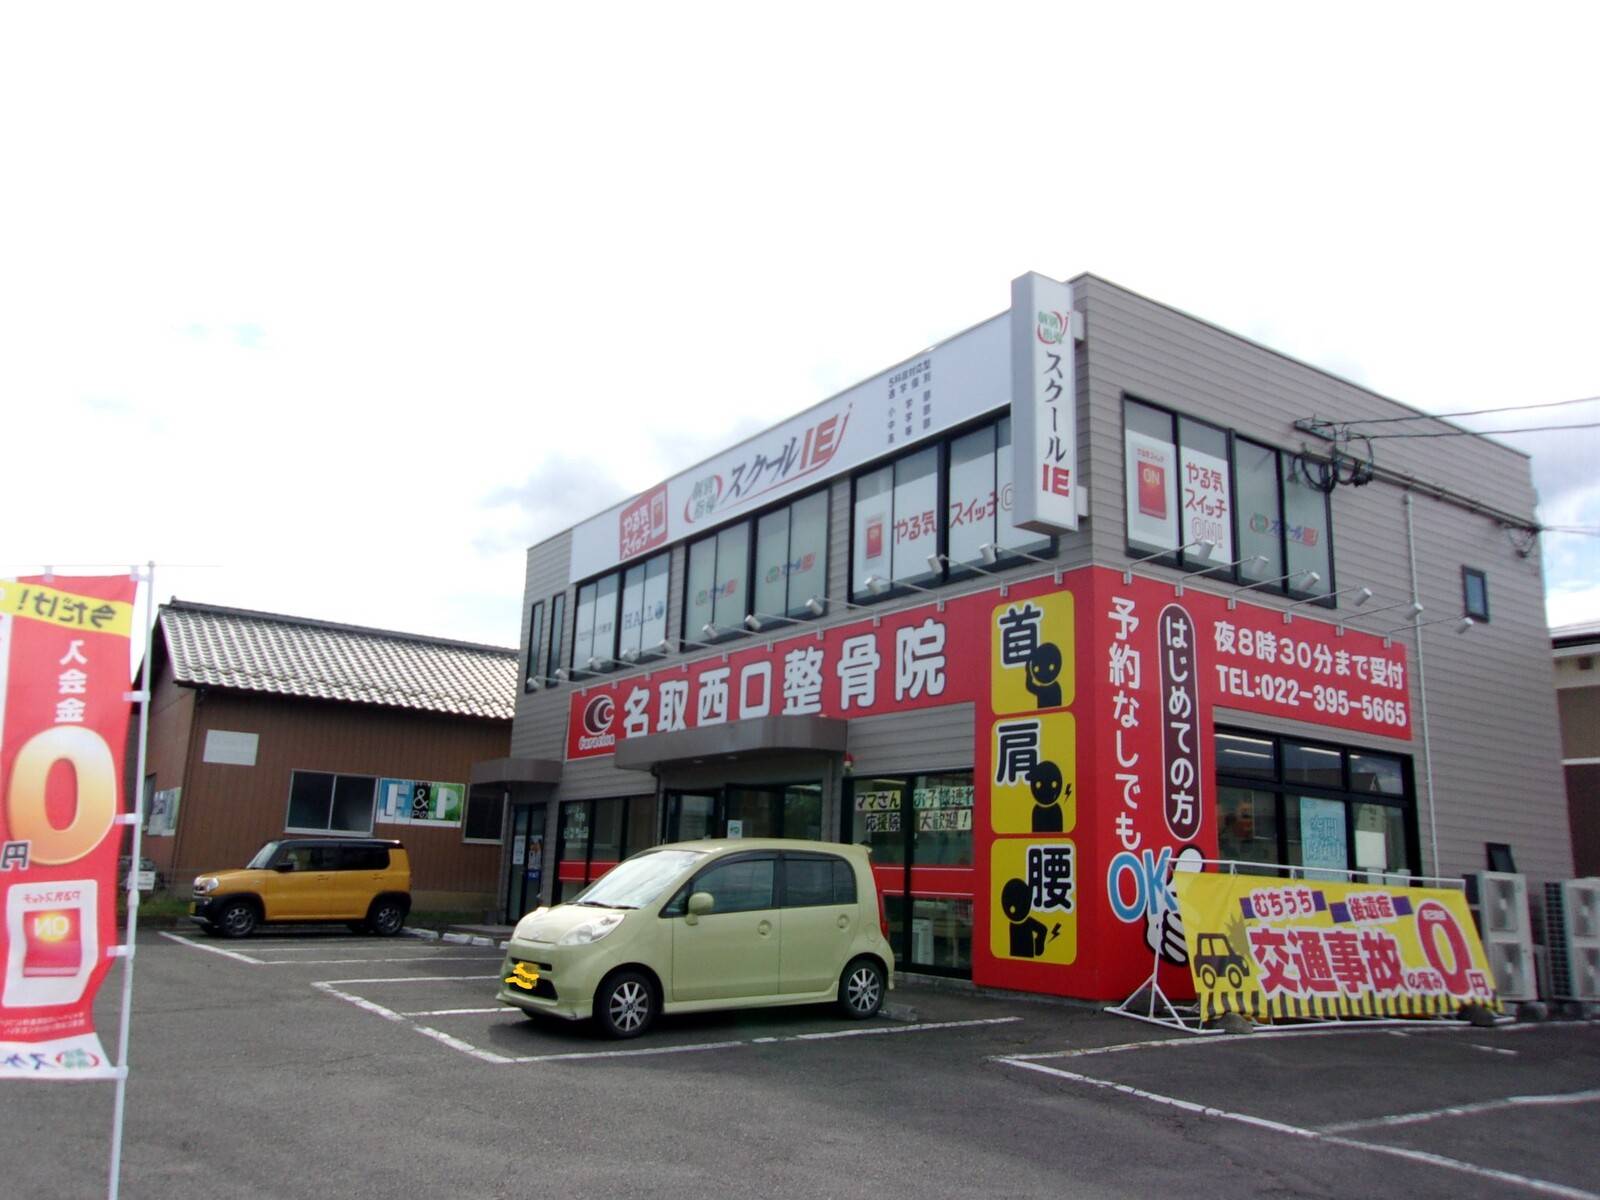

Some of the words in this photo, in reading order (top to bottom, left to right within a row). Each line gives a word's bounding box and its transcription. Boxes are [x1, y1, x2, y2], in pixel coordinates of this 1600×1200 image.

[1044, 351, 1066, 463] スクール
[1042, 463, 1070, 497] IE
[1184, 488, 1227, 519] スイッチ
[1185, 461, 1224, 494] やる気
[893, 510, 937, 544] やる気
[949, 491, 999, 528] スイッチ
[999, 604, 1041, 666] 首
[1214, 620, 1404, 690] 夜8時30分まで受付
[622, 618, 946, 739] 名取西口整骨院
[1215, 664, 1407, 726] TEL:022-395-5665
[1108, 597, 1142, 851] 予約なしでも
[1165, 616, 1195, 825] はじめての方
[996, 721, 1040, 784] 肩
[856, 792, 899, 809] ママさん
[1028, 846, 1073, 911] 腰
[1108, 847, 1178, 922] OK
[1252, 889, 1313, 918] むちうち
[1348, 895, 1395, 920] 後遺症
[1250, 927, 1406, 995] 交通事故
[1469, 973, 1489, 996] 円
